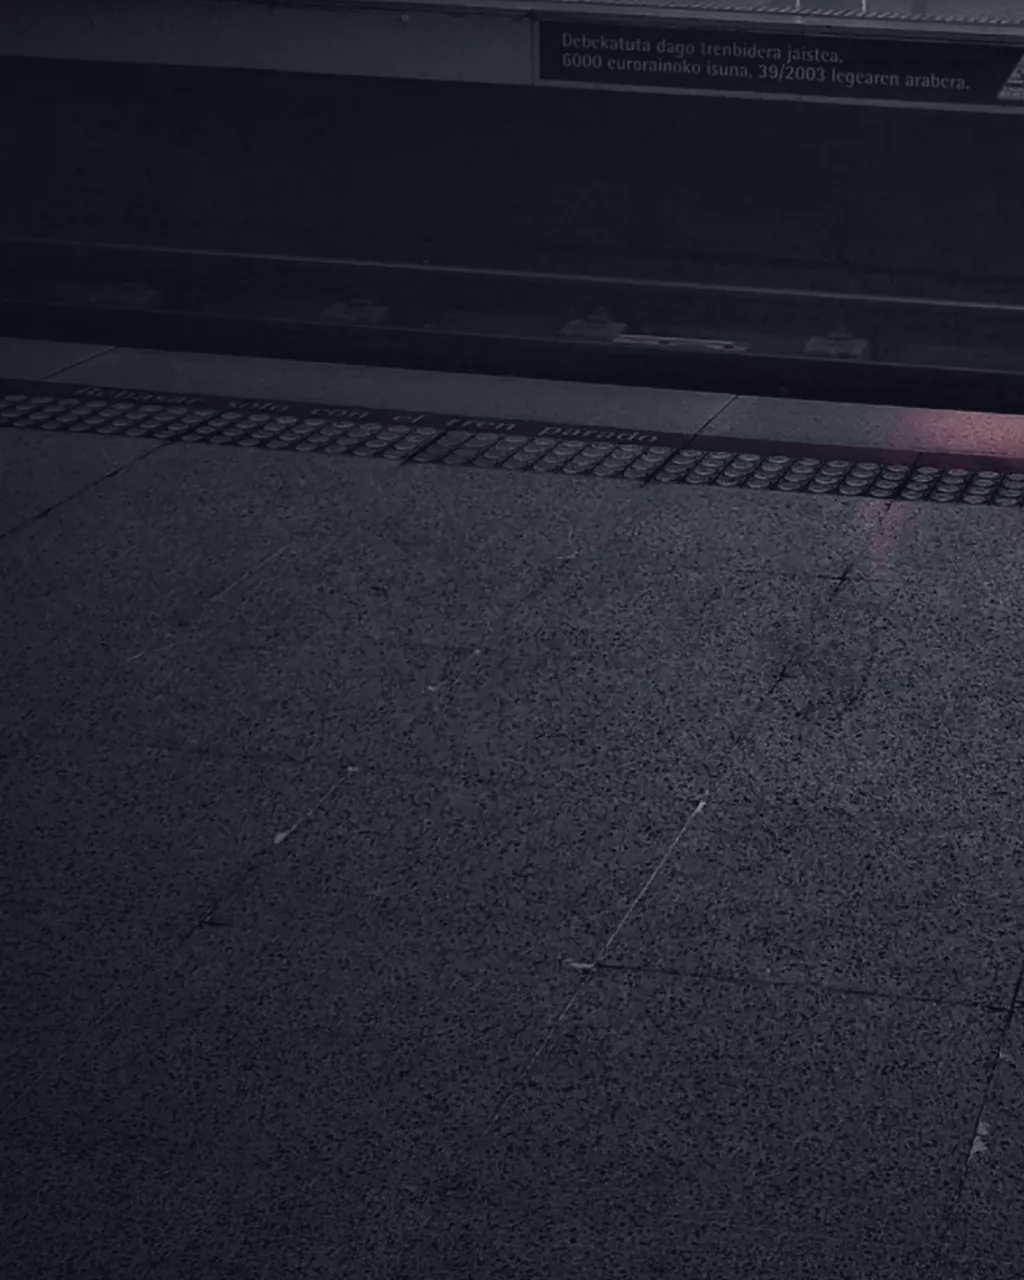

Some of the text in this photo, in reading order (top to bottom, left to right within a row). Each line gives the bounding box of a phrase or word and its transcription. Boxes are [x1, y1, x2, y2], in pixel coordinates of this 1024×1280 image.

[562, 32, 651, 53] Debekatuta
[656, 38, 695, 57] dago
[700, 40, 781, 60] trenbidera
[562, 53, 602, 70] 6000
[607, 56, 701, 76] eurorainoko
[758, 64, 827, 84] 39/2003
[831, 68, 900, 88] legearen
[905, 72, 970, 91] arabera.
[537, 426, 659, 443] parado
